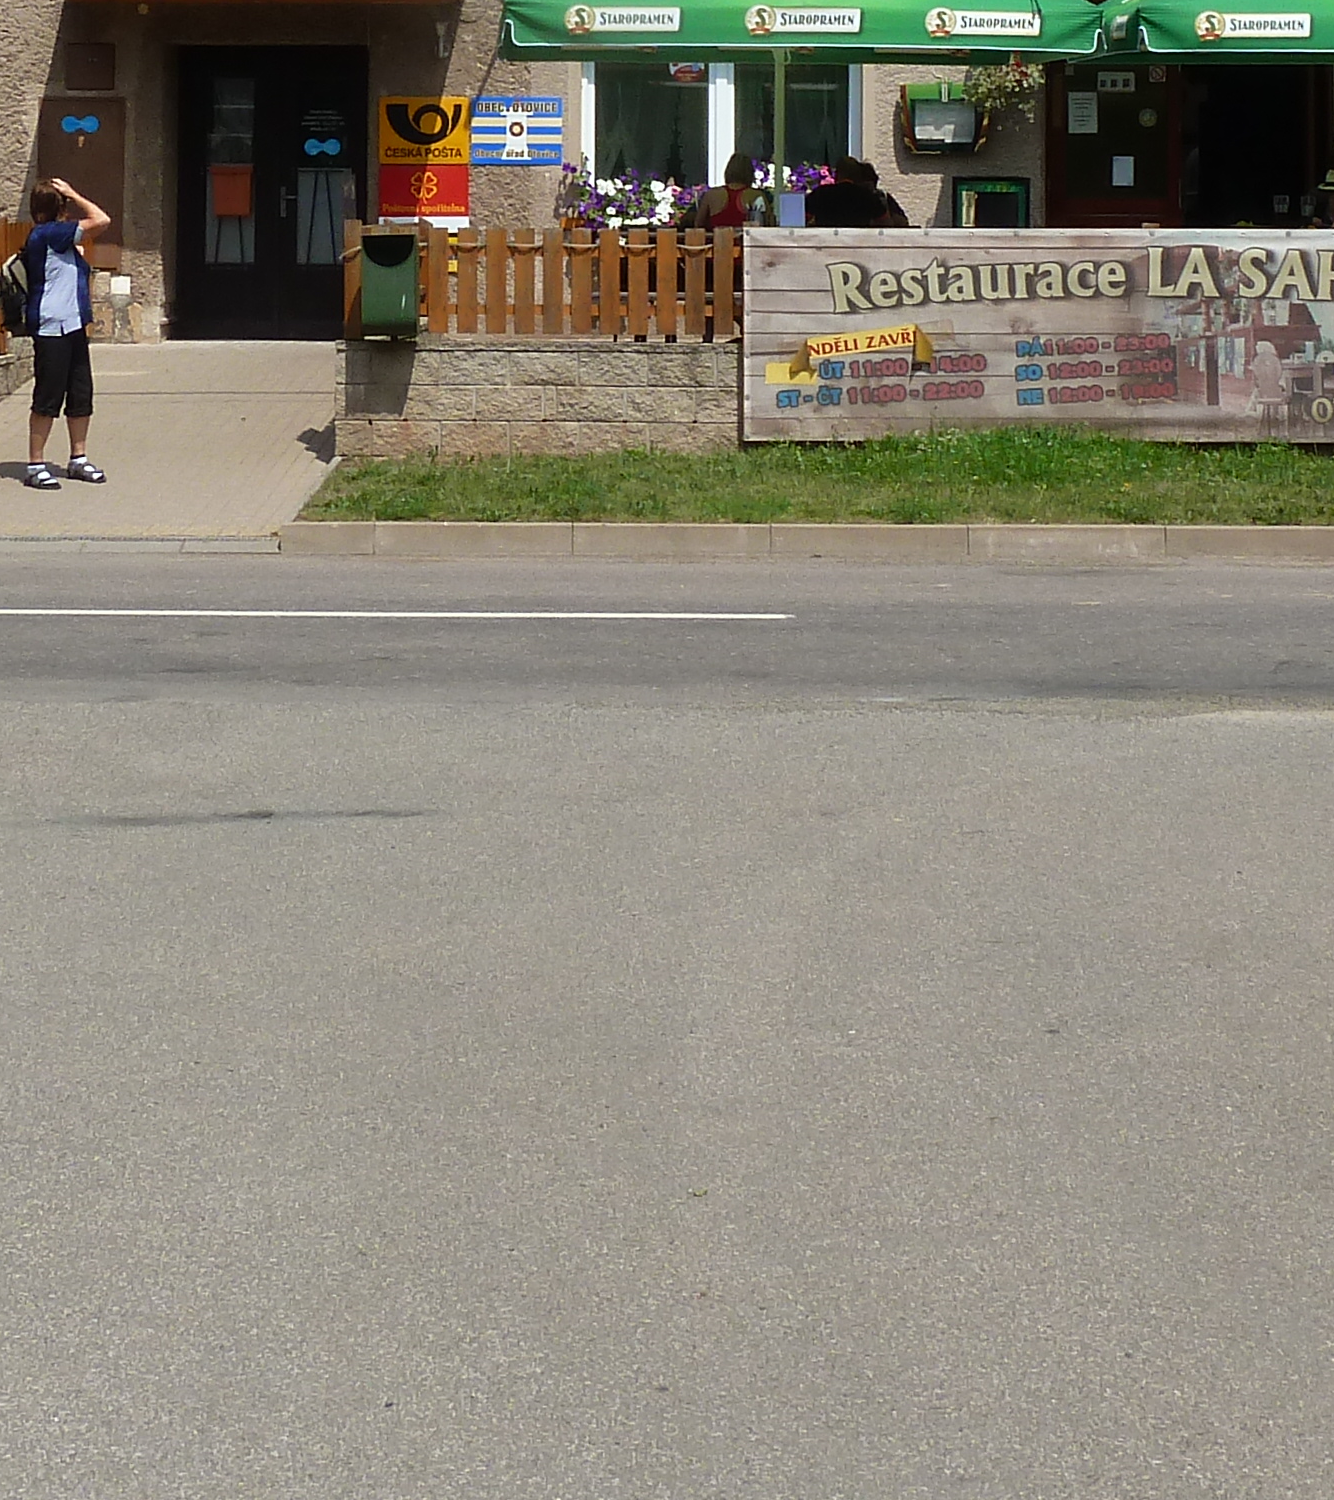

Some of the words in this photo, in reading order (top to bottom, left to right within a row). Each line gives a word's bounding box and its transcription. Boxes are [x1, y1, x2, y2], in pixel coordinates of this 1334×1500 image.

[599, 11, 674, 26] STAROPRAMEN
[780, 11, 854, 27] STAROPRAMEN
[960, 15, 1035, 30] STAROPRAMEN
[1229, 17, 1305, 32] STAROPRAMEN
[477, 102, 505, 112] OBEC
[512, 102, 557, 112] OTOVICE
[385, 146, 423, 158] ČESKÁ
[425, 146, 462, 158] POŠTA
[826, 257, 1127, 314] Restaurace
[1146, 245, 1221, 298] LA
[849, 357, 909, 379] 11:00
[1015, 363, 1044, 382] SO
[776, 389, 801, 408] ST
[817, 385, 845, 406] ČT
[847, 384, 907, 404] 11:00
[923, 380, 985, 401] 22:00
[1016, 387, 1044, 406] NE
